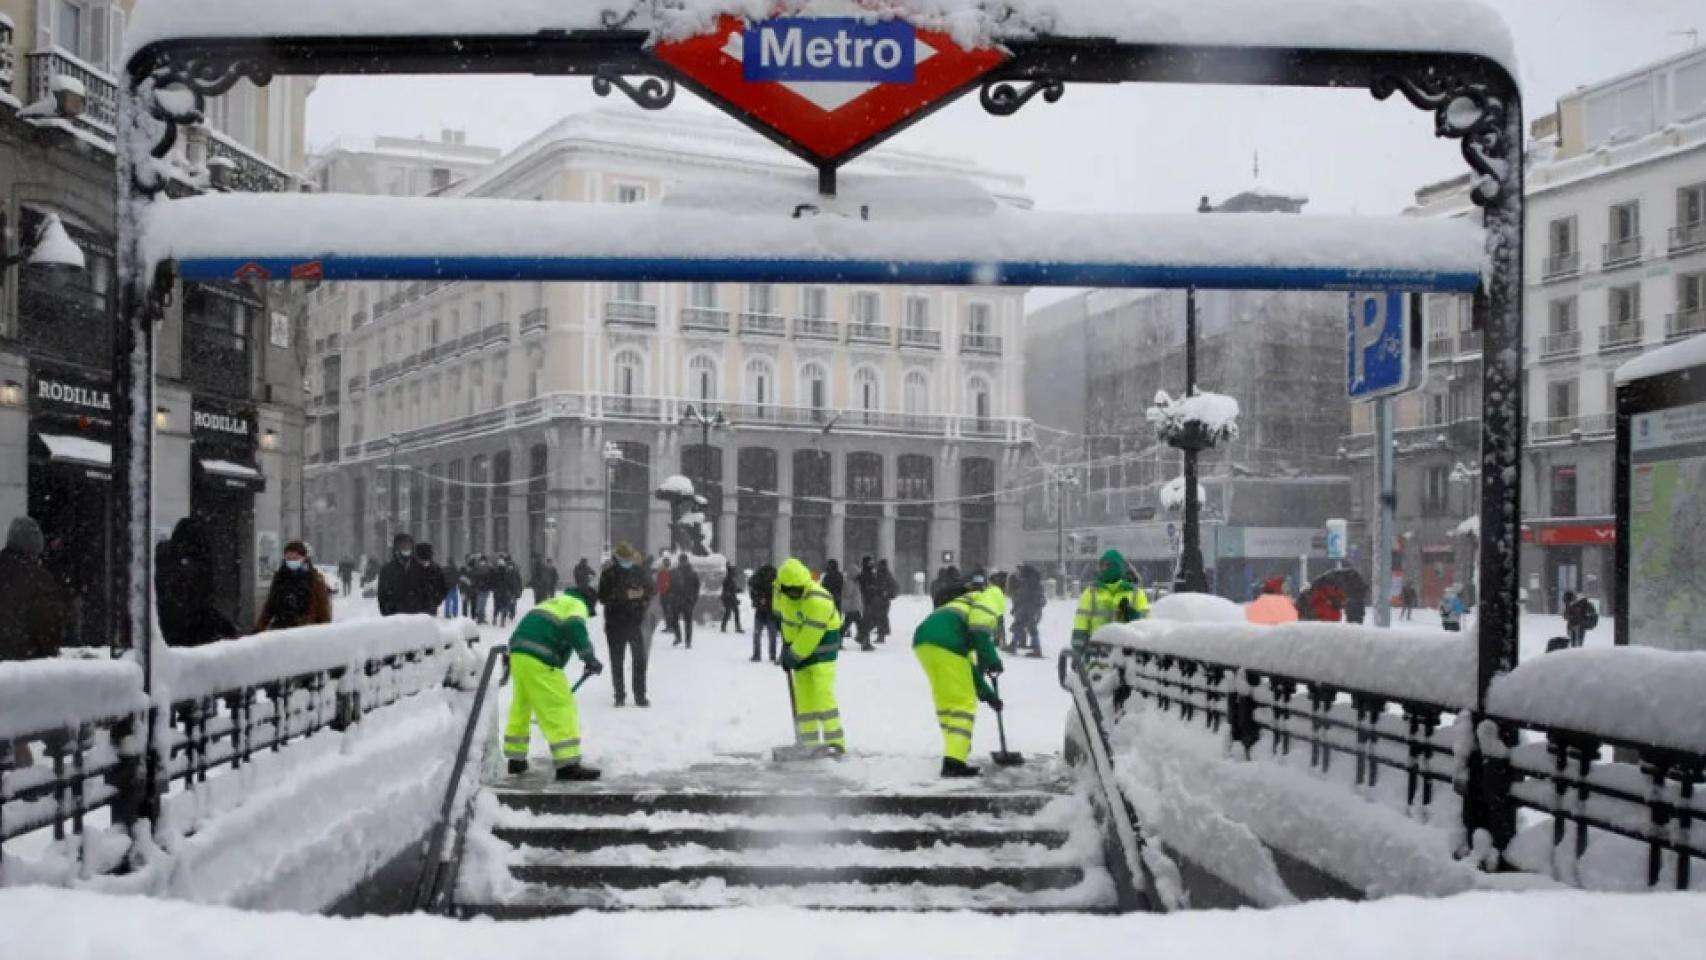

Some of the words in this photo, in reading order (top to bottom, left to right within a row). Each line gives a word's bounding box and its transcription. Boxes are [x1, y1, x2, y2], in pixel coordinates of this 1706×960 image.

[760, 27, 902, 69] Metro
[1353, 290, 1387, 382] P
[38, 379, 111, 410] RODILLA
[193, 411, 248, 434] RODILLA
